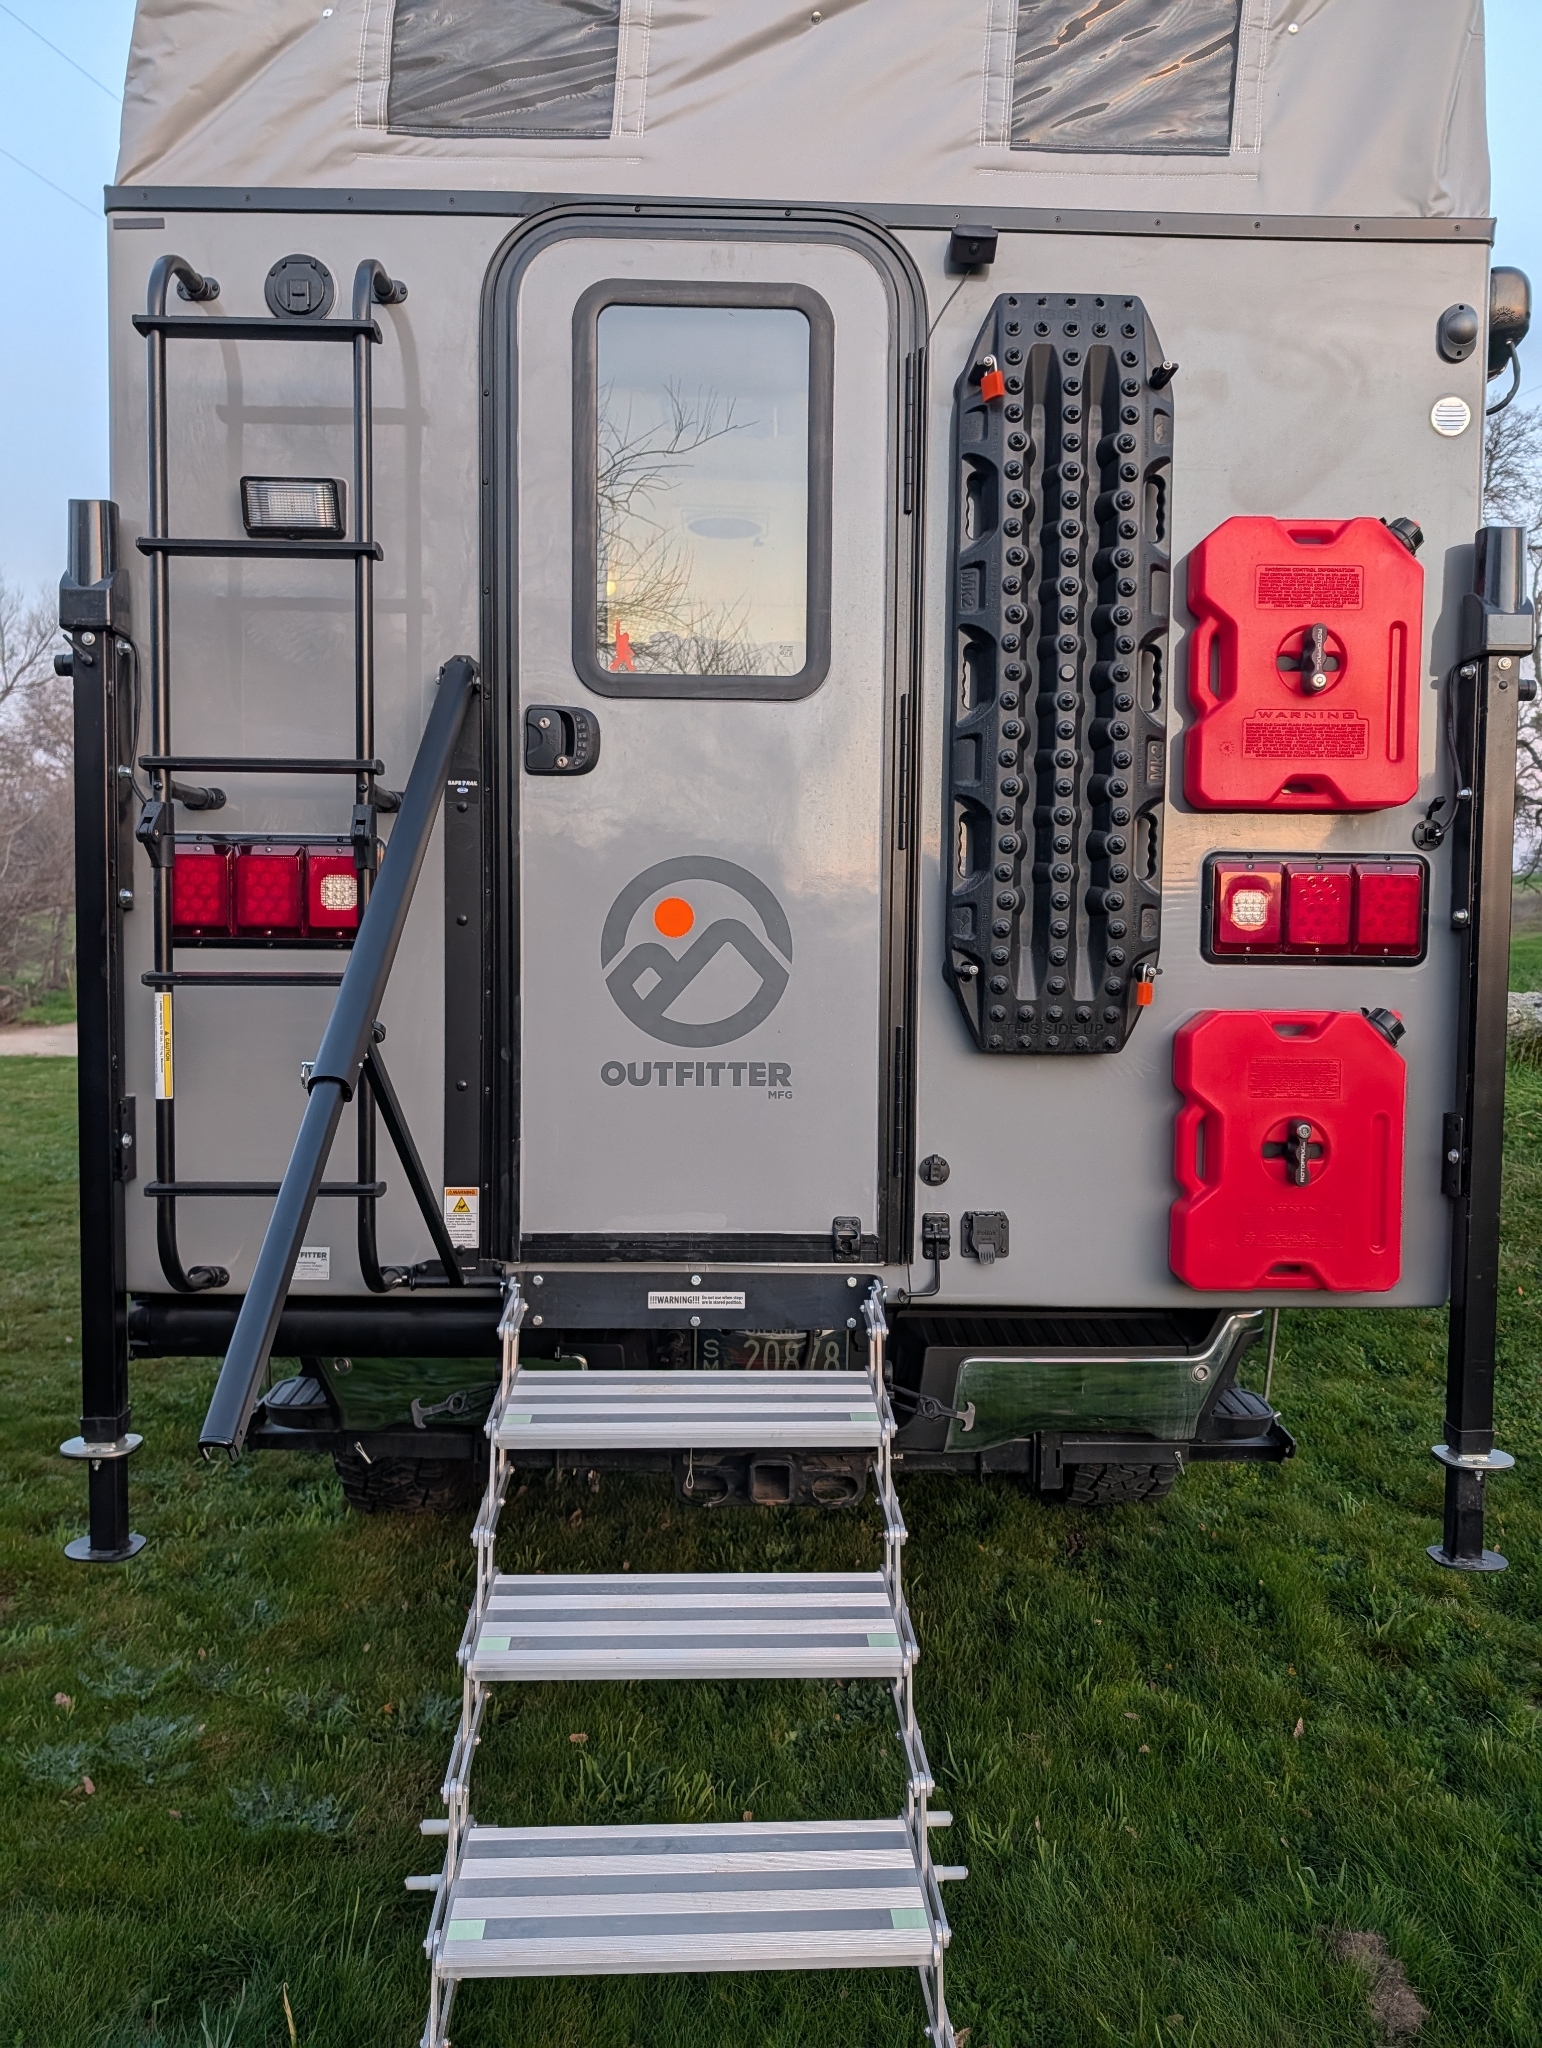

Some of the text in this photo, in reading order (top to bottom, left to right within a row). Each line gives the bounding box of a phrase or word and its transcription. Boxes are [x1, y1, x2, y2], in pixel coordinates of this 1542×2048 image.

[960, 571, 978, 608] Mk2
[1258, 711, 1355, 720] WARNING
[1150, 742, 1164, 781] Mk2
[1005, 1023, 1104, 1035] THIS SIDE UP
[600, 1060, 793, 1087] OUTFITTER
[768, 1091, 793, 1100] MFG
[649, 1296, 700, 1304] !!!WARNING!!!
[703, 1339, 720, 1358] S
